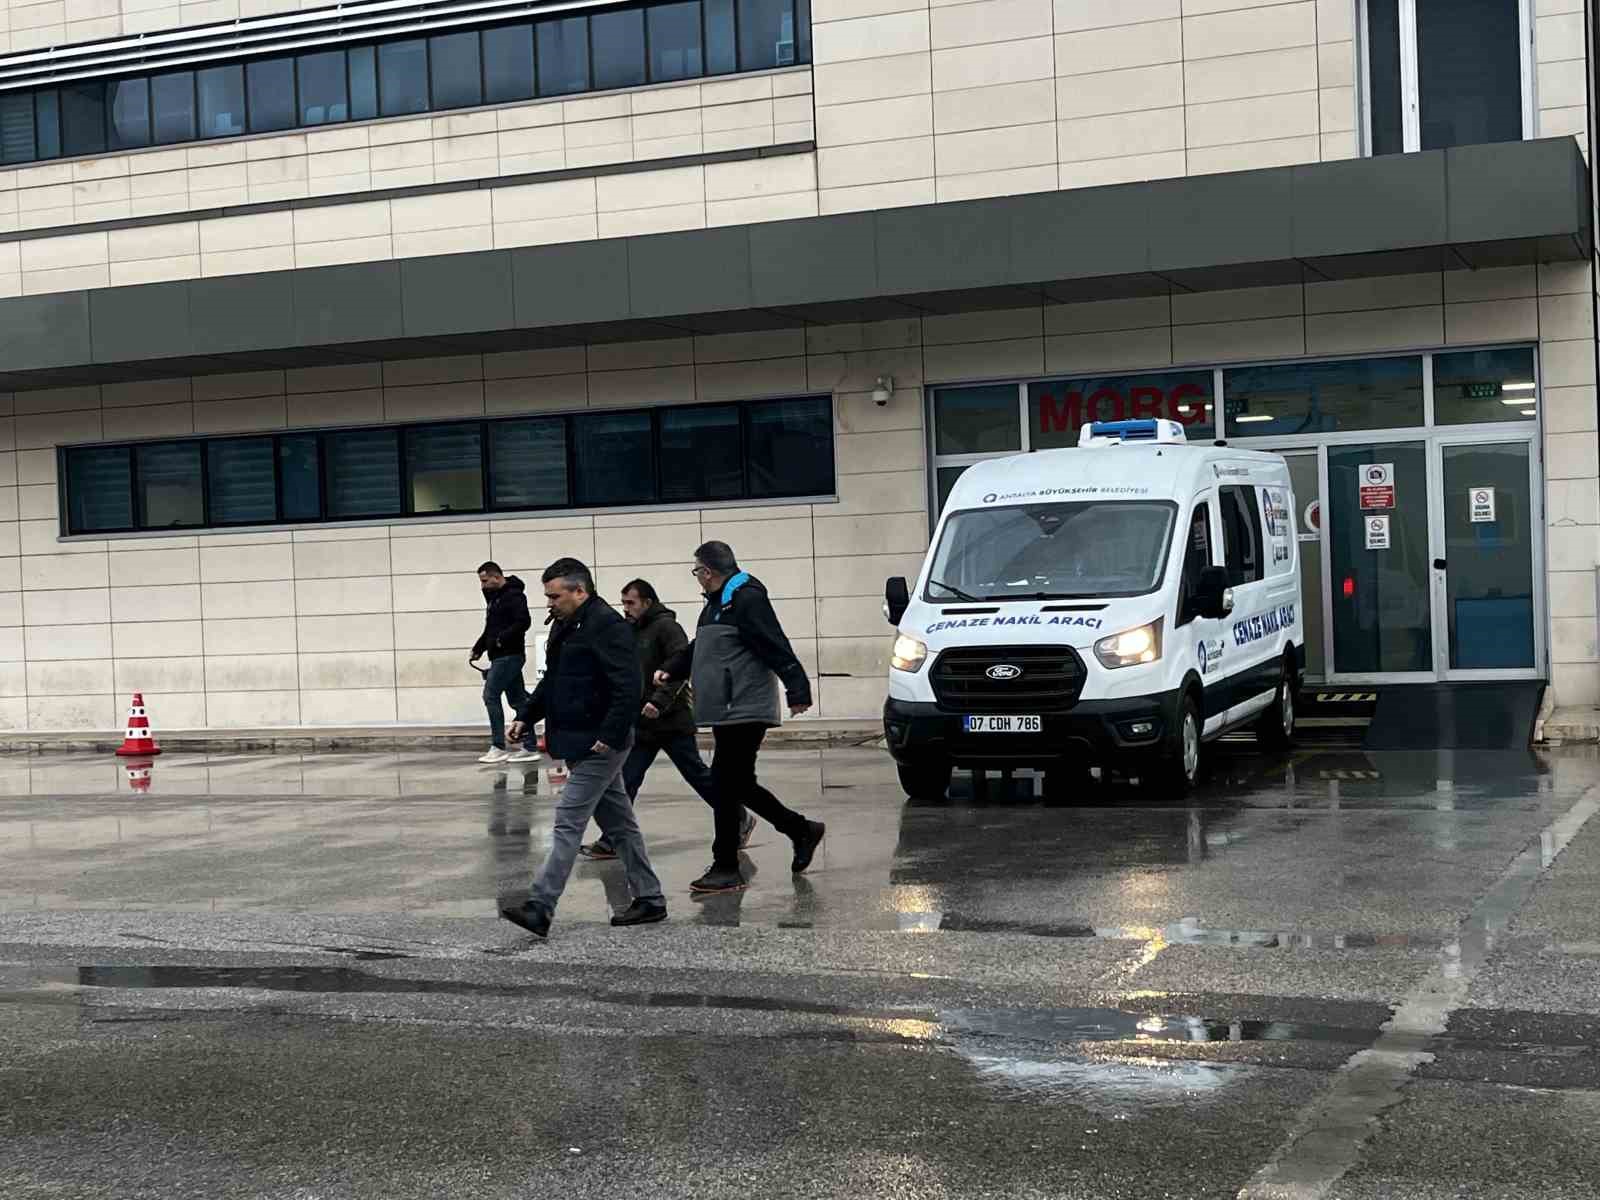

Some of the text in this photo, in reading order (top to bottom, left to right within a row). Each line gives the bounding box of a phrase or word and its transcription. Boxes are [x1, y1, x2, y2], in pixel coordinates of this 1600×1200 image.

[1040, 383, 1206, 432] MORG
[999, 491, 1036, 500] ANTALYA
[926, 614, 1103, 634] CENAZE NAKİL ARACI
[1233, 616, 1262, 646] CENAZE
[989, 666, 1016, 678] Ford
[970, 716, 984, 730] 07
[989, 716, 1011, 730] CDH
[1017, 716, 1039, 730] 786
